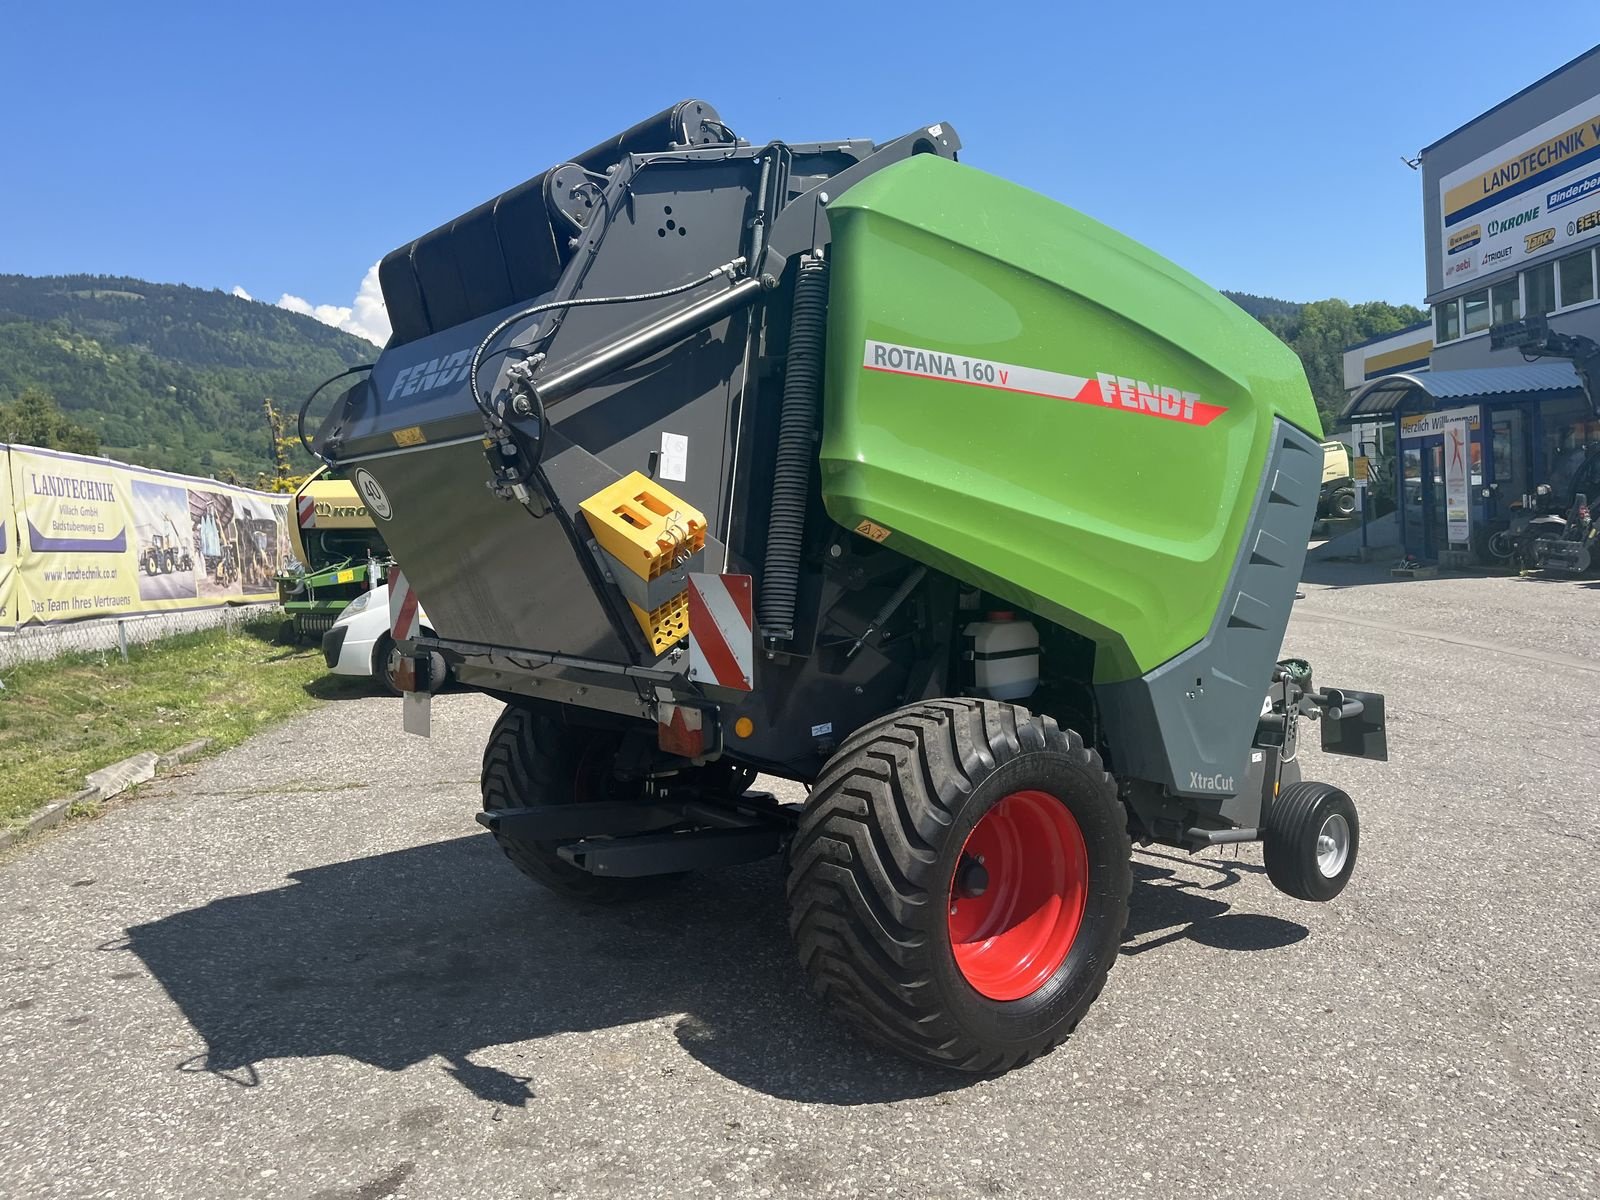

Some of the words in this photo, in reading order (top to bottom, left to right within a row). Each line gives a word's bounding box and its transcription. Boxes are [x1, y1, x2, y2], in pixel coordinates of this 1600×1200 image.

[1483, 128, 1585, 194] LANDTECHNIK
[1500, 206, 1540, 233] KRONE
[1577, 211, 1600, 233] BER
[1456, 258, 1471, 272] aebi
[874, 344, 957, 377] ROTANA
[962, 360, 995, 383] 160
[999, 370, 1009, 385] V
[1096, 371, 1201, 420] FENDT
[1402, 418, 1429, 434] Herzlich
[32, 473, 116, 502] LANDTECHNIK
[364, 480, 381, 500] 40
[59, 504, 79, 516] Villach
[80, 506, 99, 517] GmbH
[333, 505, 368, 516] KRO
[52, 520, 95, 534] Badstubenweg
[44, 566, 118, 581] www.landtechnik.co.at
[32, 600, 45, 613] Das
[47, 598, 69, 611] Team
[72, 596, 92, 609] Ihres
[94, 595, 131, 608] Vertrauens
[1189, 771, 1234, 791] XtraCut
